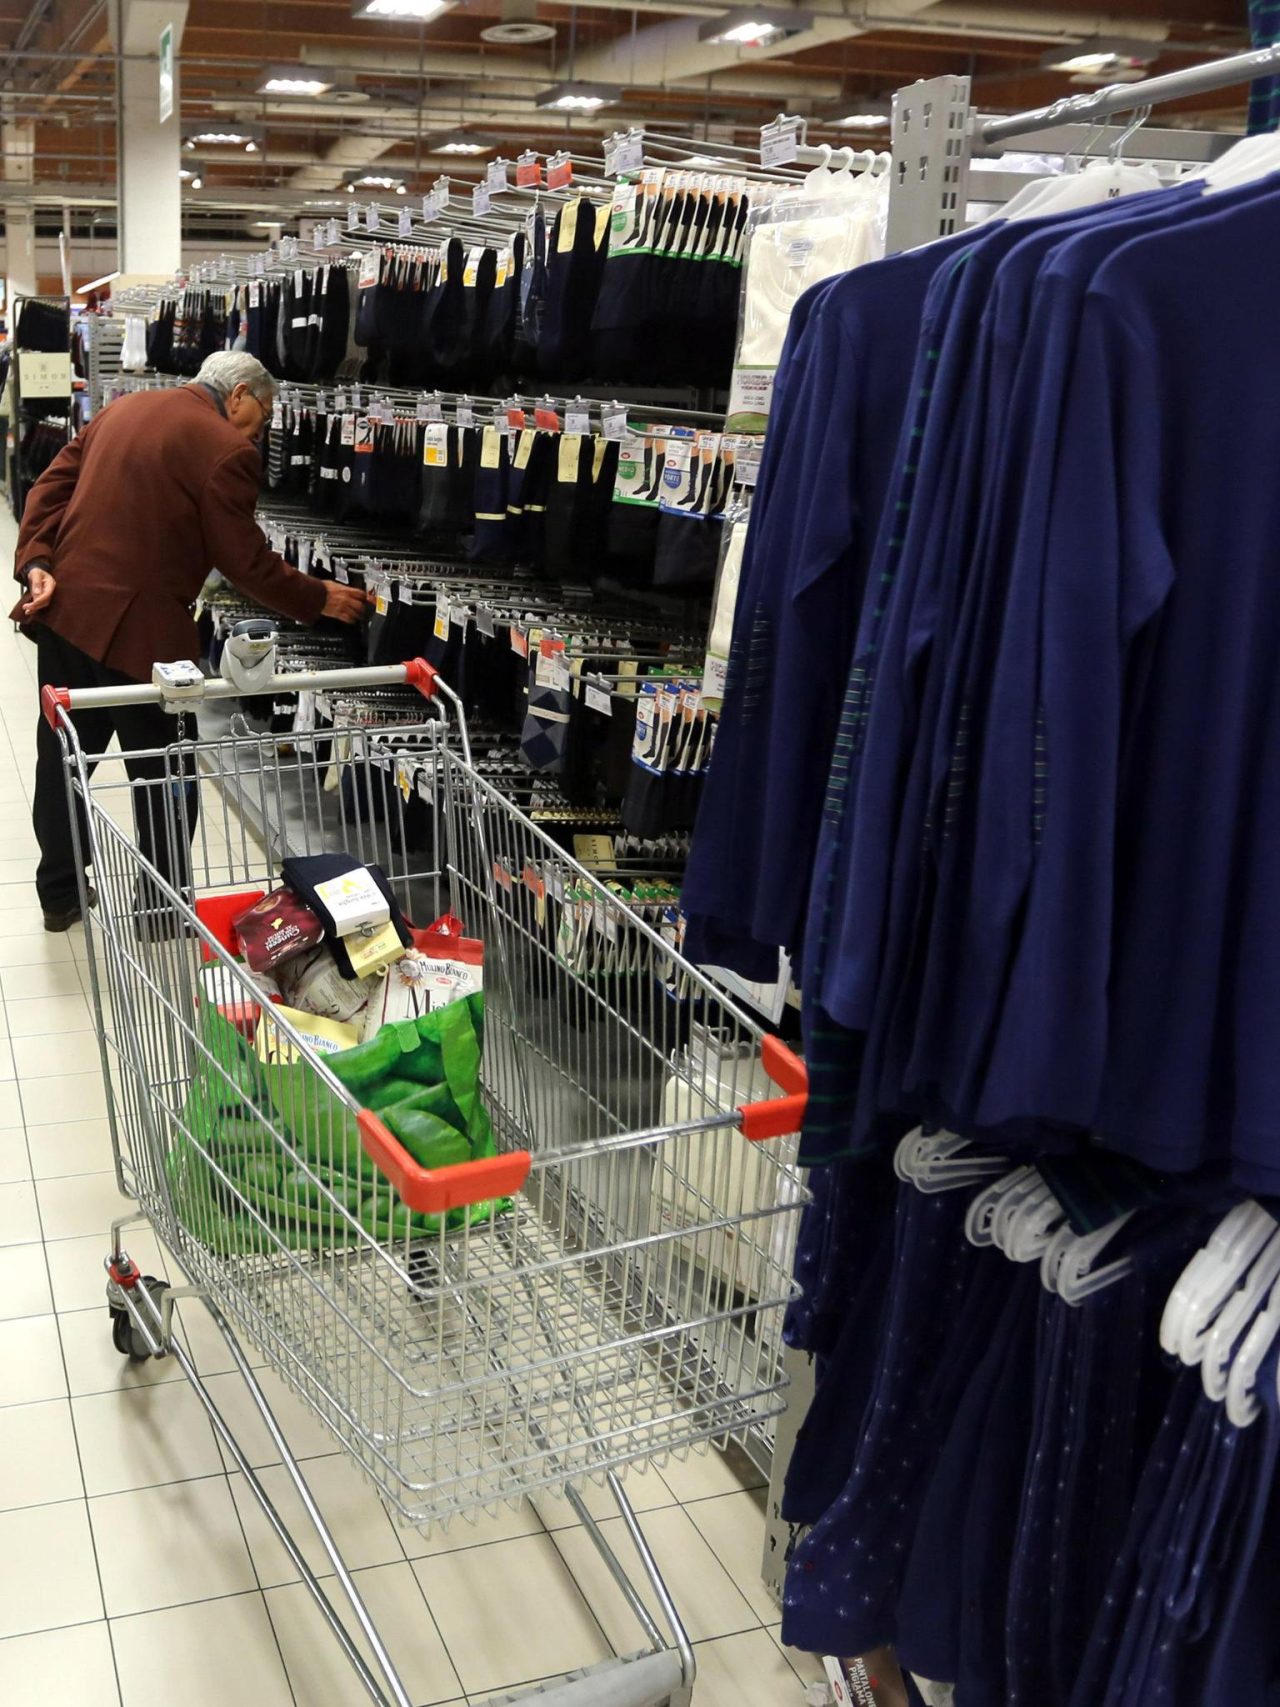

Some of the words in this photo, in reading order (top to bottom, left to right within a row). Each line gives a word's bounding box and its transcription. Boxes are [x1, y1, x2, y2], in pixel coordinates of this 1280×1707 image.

[419, 960, 446, 975] MULINO
[445, 962, 469, 981] BIANCO
[313, 1034, 339, 1051] BIANCO
[848, 1666, 866, 1705] PIGIAMA
[854, 1657, 877, 1707] PANTALONE
